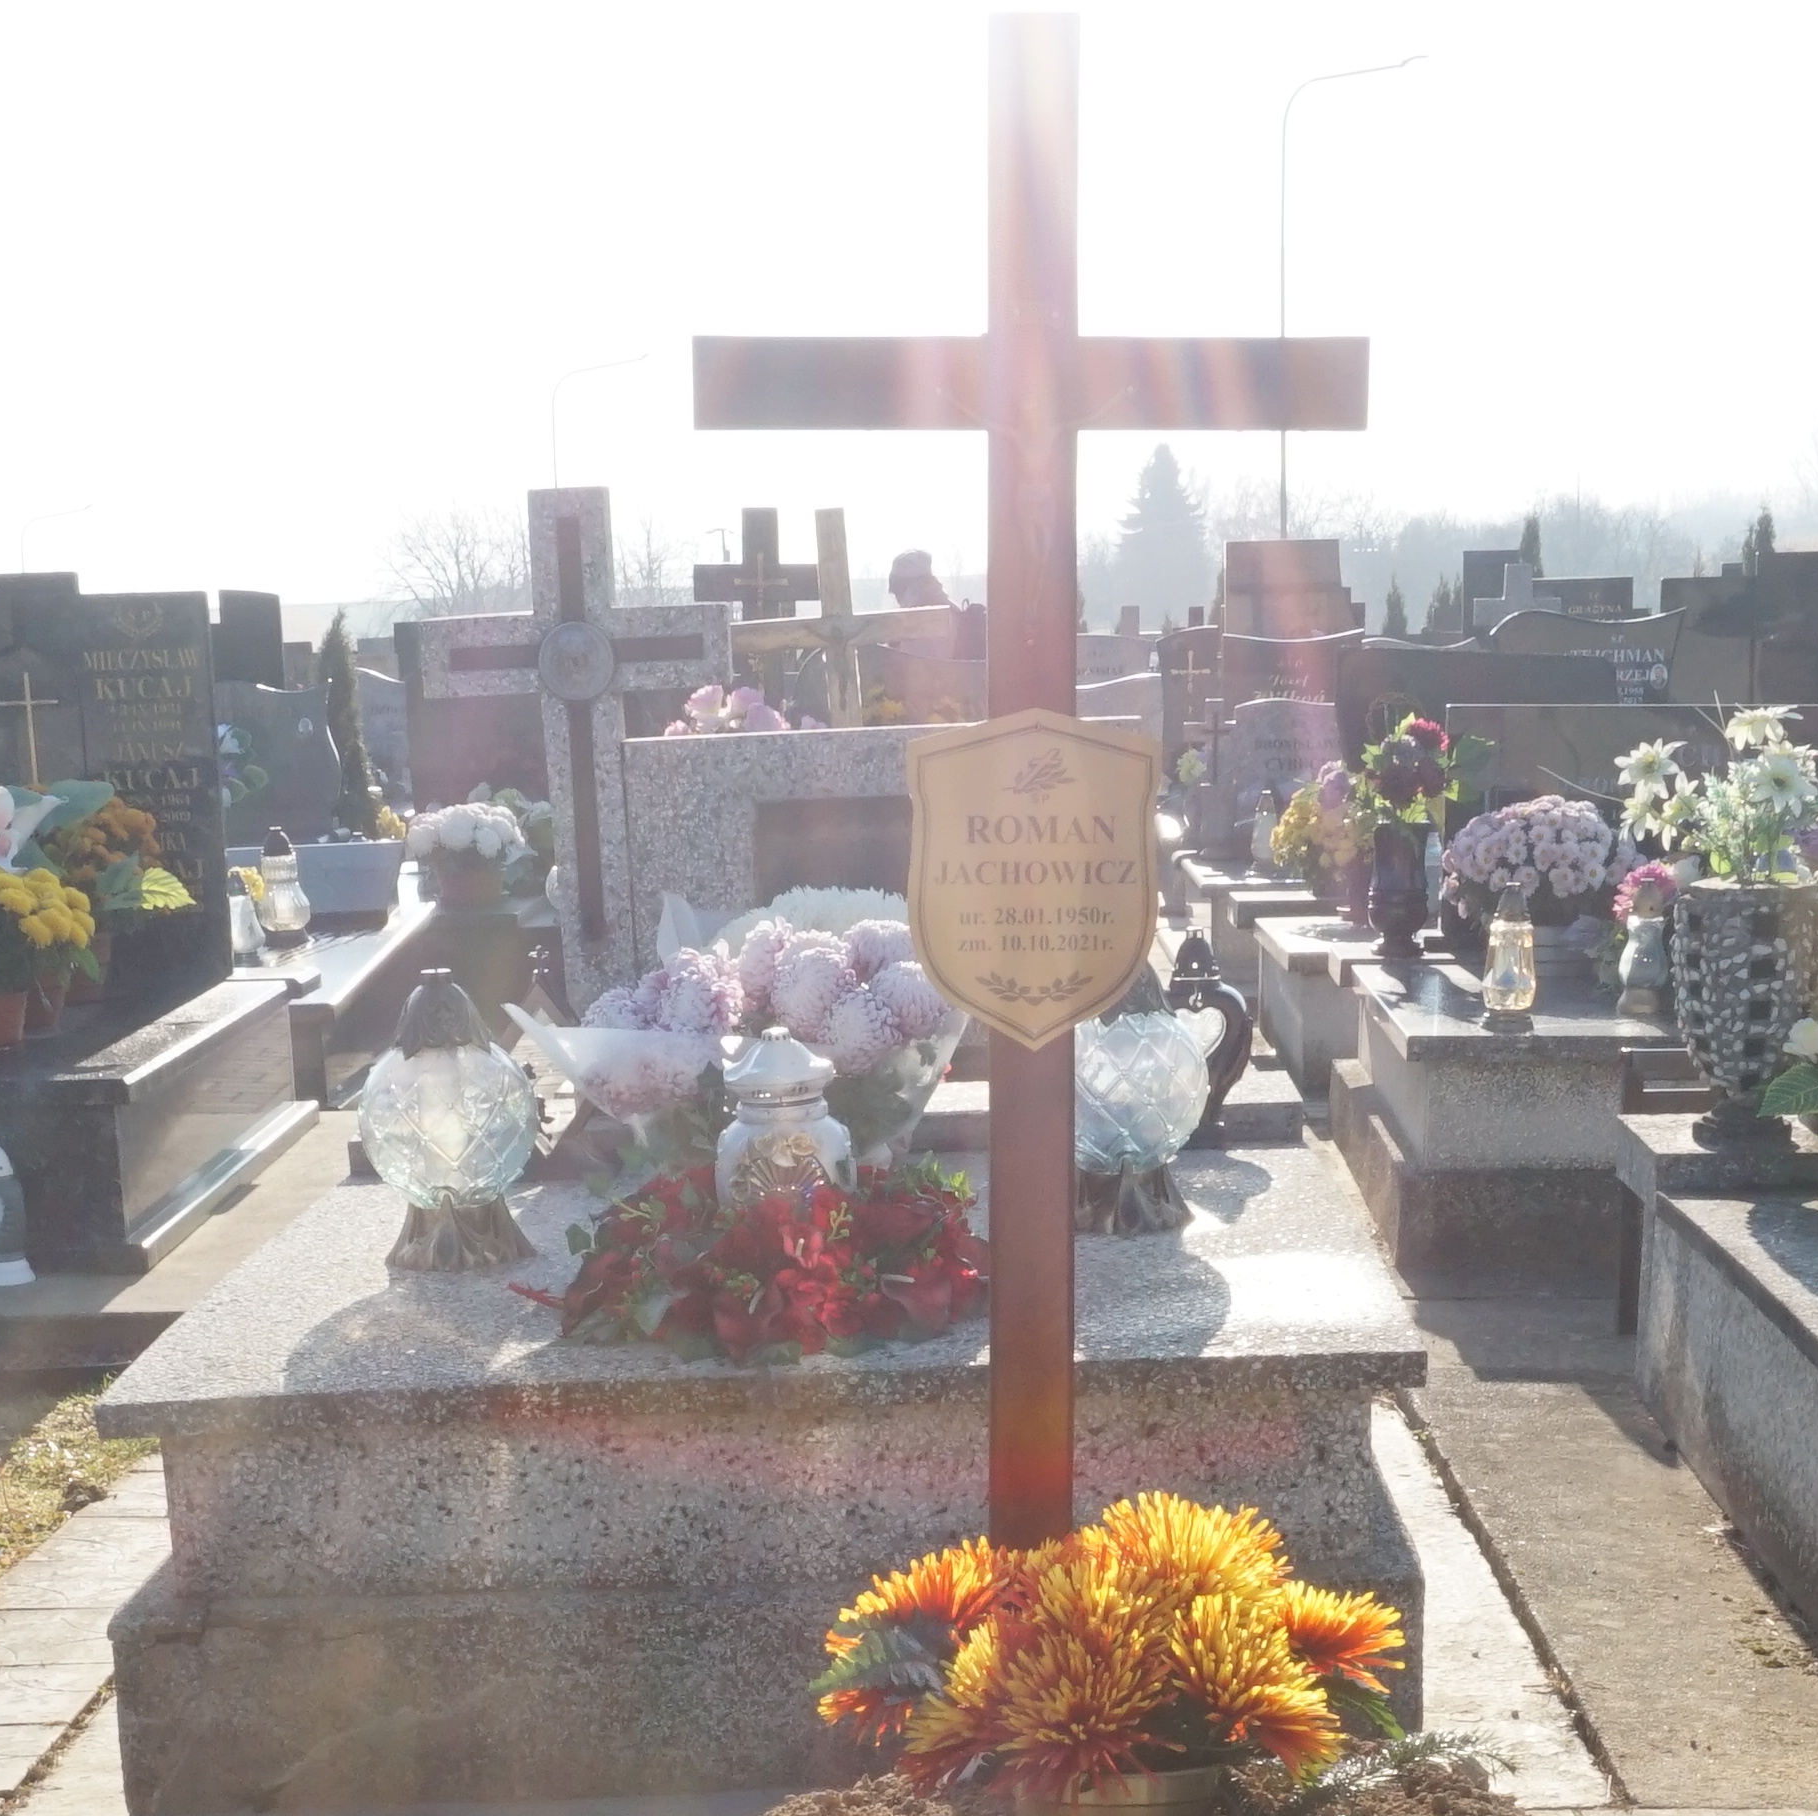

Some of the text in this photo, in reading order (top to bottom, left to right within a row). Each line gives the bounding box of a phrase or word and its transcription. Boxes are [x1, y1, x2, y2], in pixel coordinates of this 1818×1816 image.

[95, 675, 192, 701] KUCAJ
[103, 767, 200, 792] KUCAJ
[967, 815, 1116, 845] ROMAN
[934, 860, 1137, 886] JACHOWICZ
[959, 906, 1114, 926] ur. 28.01.1950r.
[958, 934, 1113, 952] zm. 10.10.2021r.
